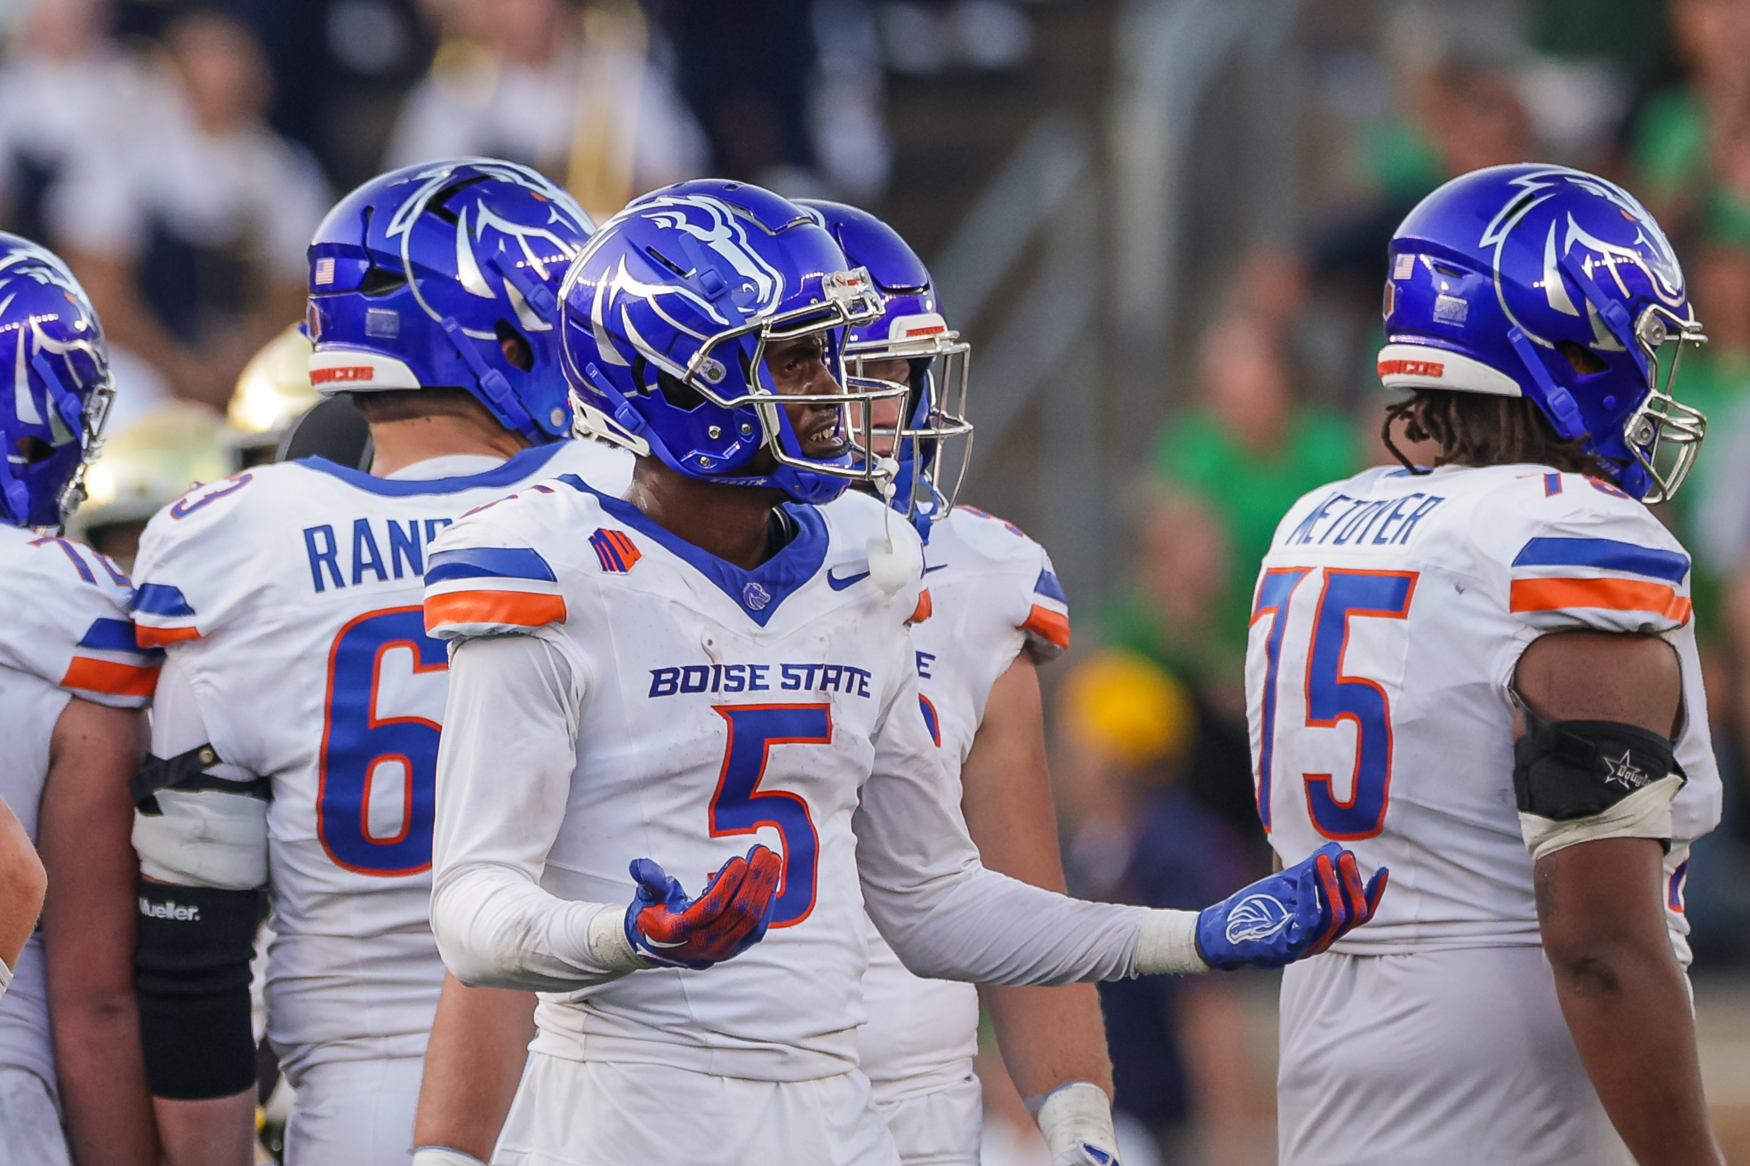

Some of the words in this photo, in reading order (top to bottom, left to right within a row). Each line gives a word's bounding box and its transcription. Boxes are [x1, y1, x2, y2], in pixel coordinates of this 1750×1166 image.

[303, 517, 453, 593] RAN
[648, 664, 770, 698] BOISE
[780, 664, 871, 698] STATE
[1248, 566, 1420, 841] 75
[707, 703, 832, 929] 5
